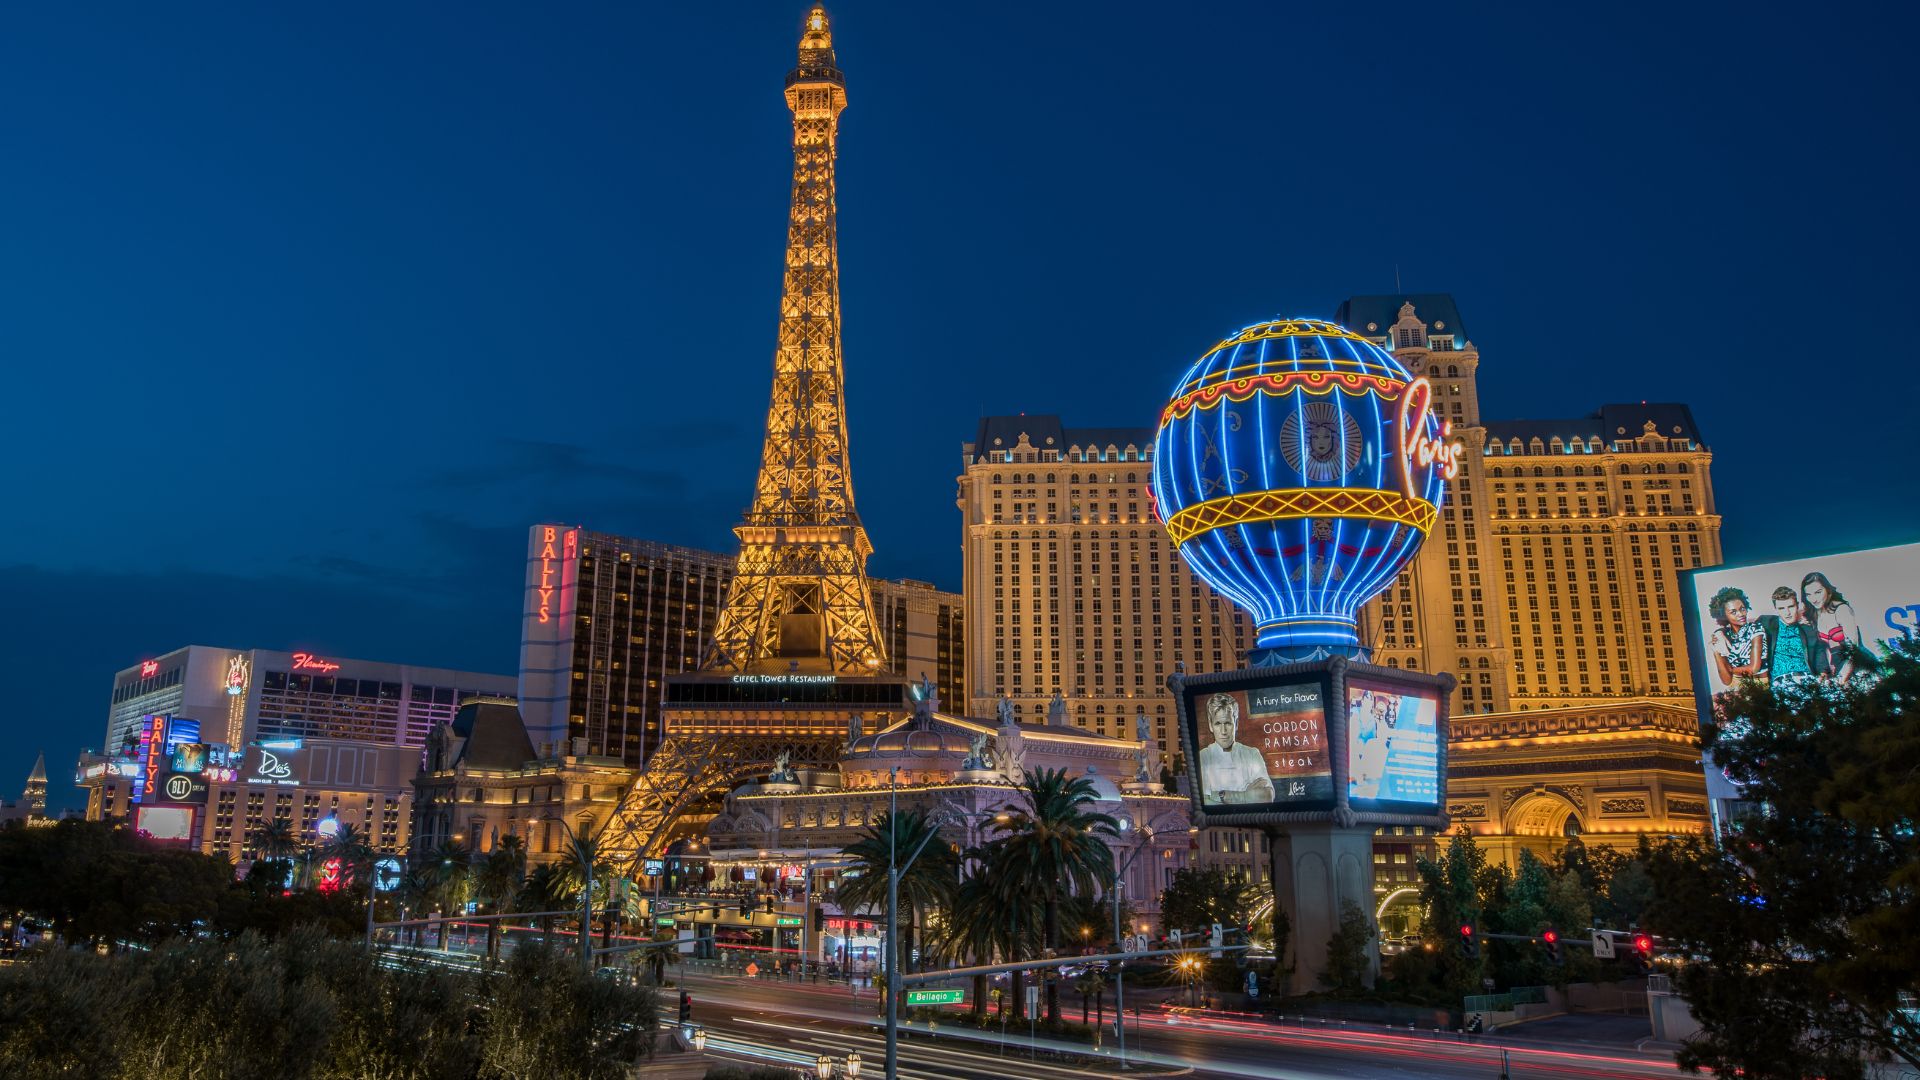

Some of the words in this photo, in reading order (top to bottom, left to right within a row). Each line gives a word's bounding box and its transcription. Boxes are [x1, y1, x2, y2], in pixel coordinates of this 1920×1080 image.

[1400, 377, 1462, 500] Paris
[292, 653, 340, 673] Flamingo
[733, 674, 759, 683] EIFFEL
[760, 674, 787, 683] TOWER
[790, 675, 836, 683] RESTAURANT
[1256, 698, 1262, 706] A
[1263, 696, 1279, 706] Fury
[1280, 694, 1293, 703] For
[1294, 693, 1318, 702] Flavor
[1263, 719, 1318, 734] GORDON
[1264, 734, 1319, 748] RAMSAY
[1274, 757, 1313, 768] steak
[171, 780, 187, 794] BLT
[916, 993, 948, 1001] Bellagio
